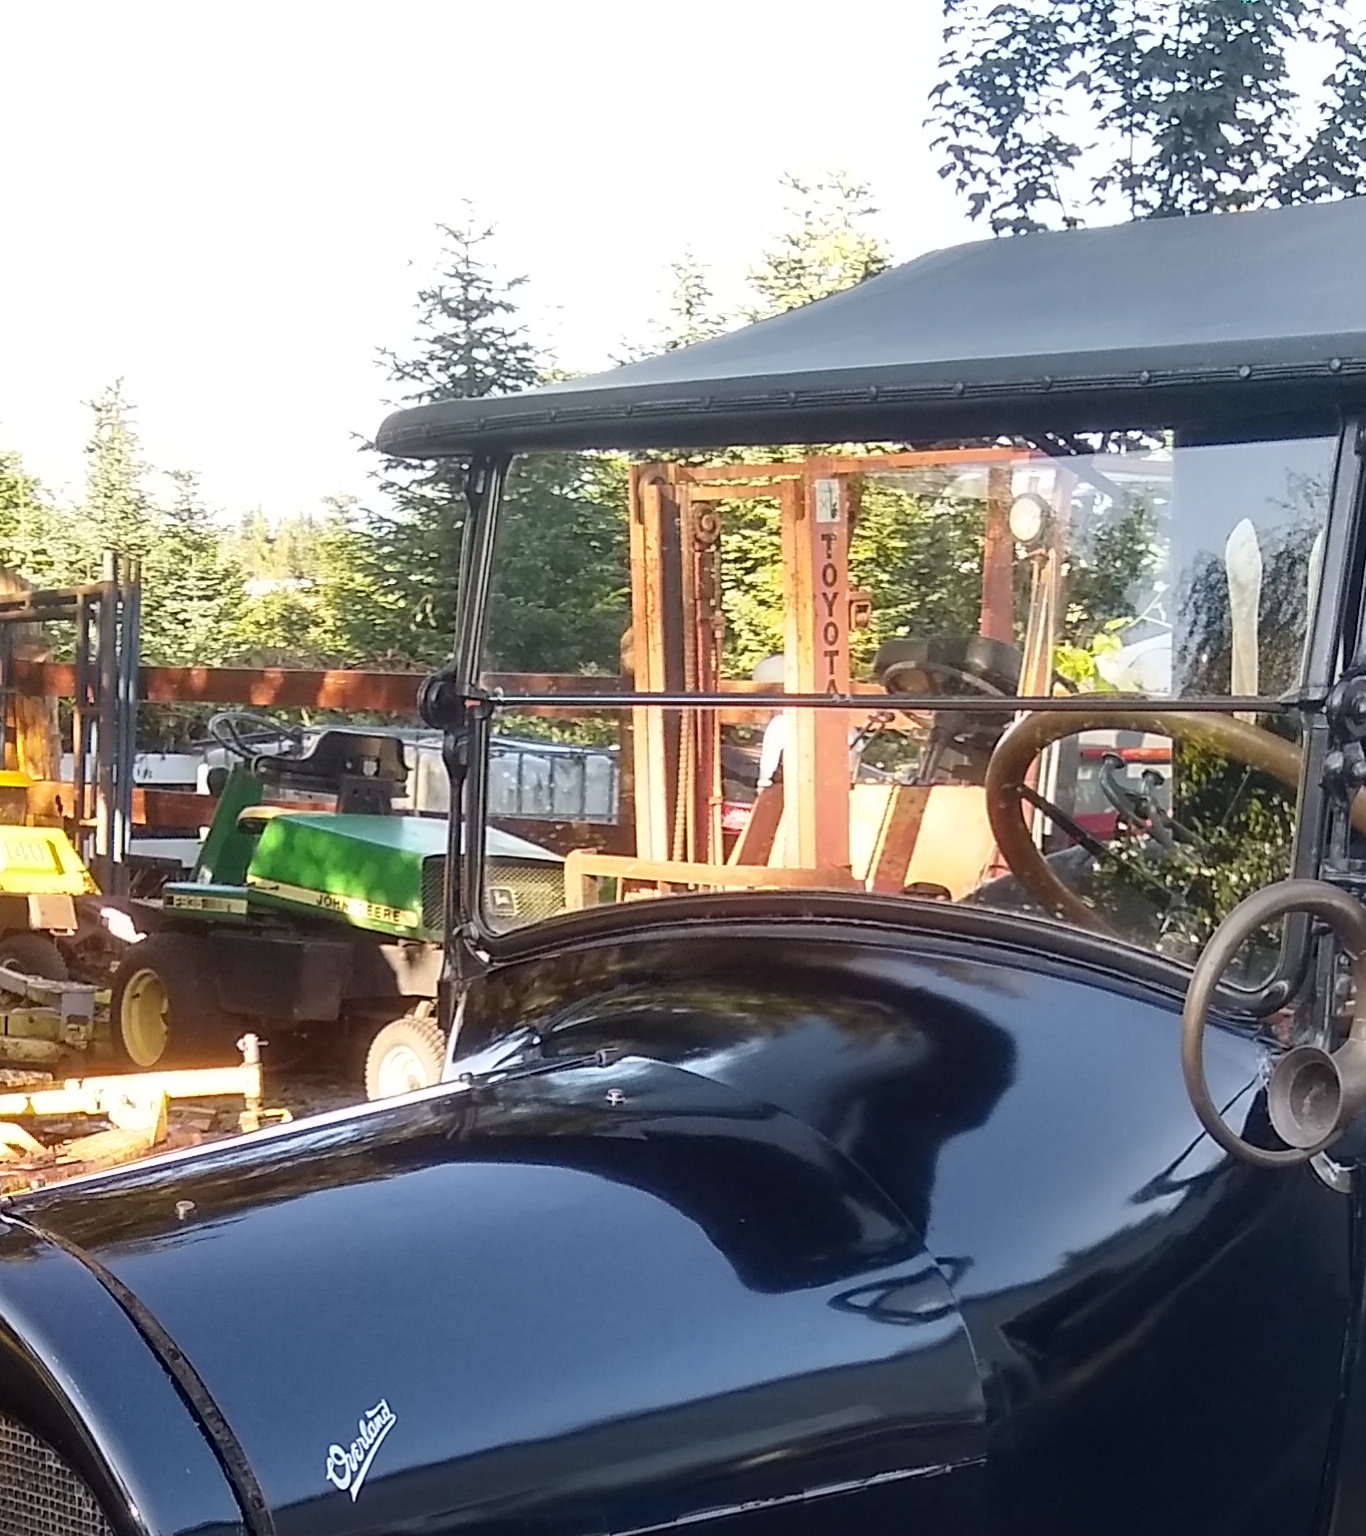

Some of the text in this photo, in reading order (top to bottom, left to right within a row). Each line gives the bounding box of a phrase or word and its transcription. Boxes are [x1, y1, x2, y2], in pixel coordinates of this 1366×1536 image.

[821, 533, 840, 695] TOYOTA
[316, 894, 349, 912] JOHN
[325, 1398, 396, 1501] Overland
